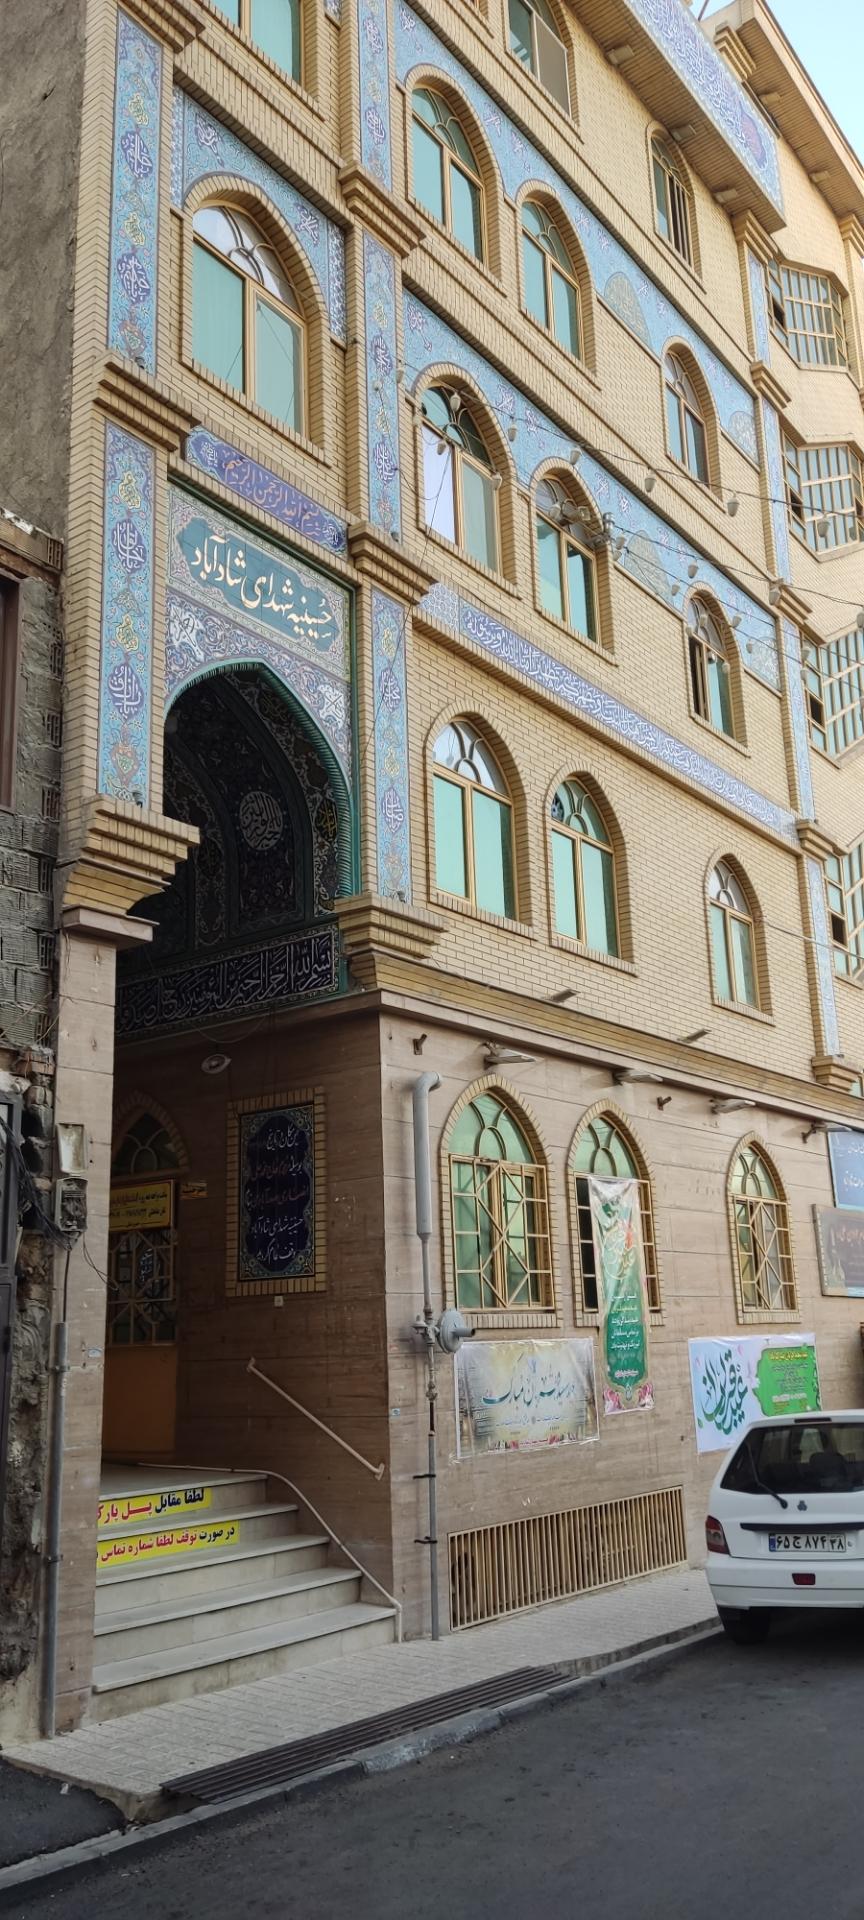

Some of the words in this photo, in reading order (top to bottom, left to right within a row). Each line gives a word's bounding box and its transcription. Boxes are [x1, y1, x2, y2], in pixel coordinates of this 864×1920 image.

[191, 534, 246, 589] شادآباد
[240, 572, 295, 616] شهدای
[154, 1494, 182, 1514] مقابل
[184, 1488, 204, 1504] لطفا
[156, 1534, 174, 1548] لطفا
[176, 1531, 197, 1546] توقف
[199, 1529, 224, 1543] صورت
[226, 1525, 235, 1540] در
[101, 1543, 125, 1562] تماس
[128, 1538, 154, 1556] شماره
